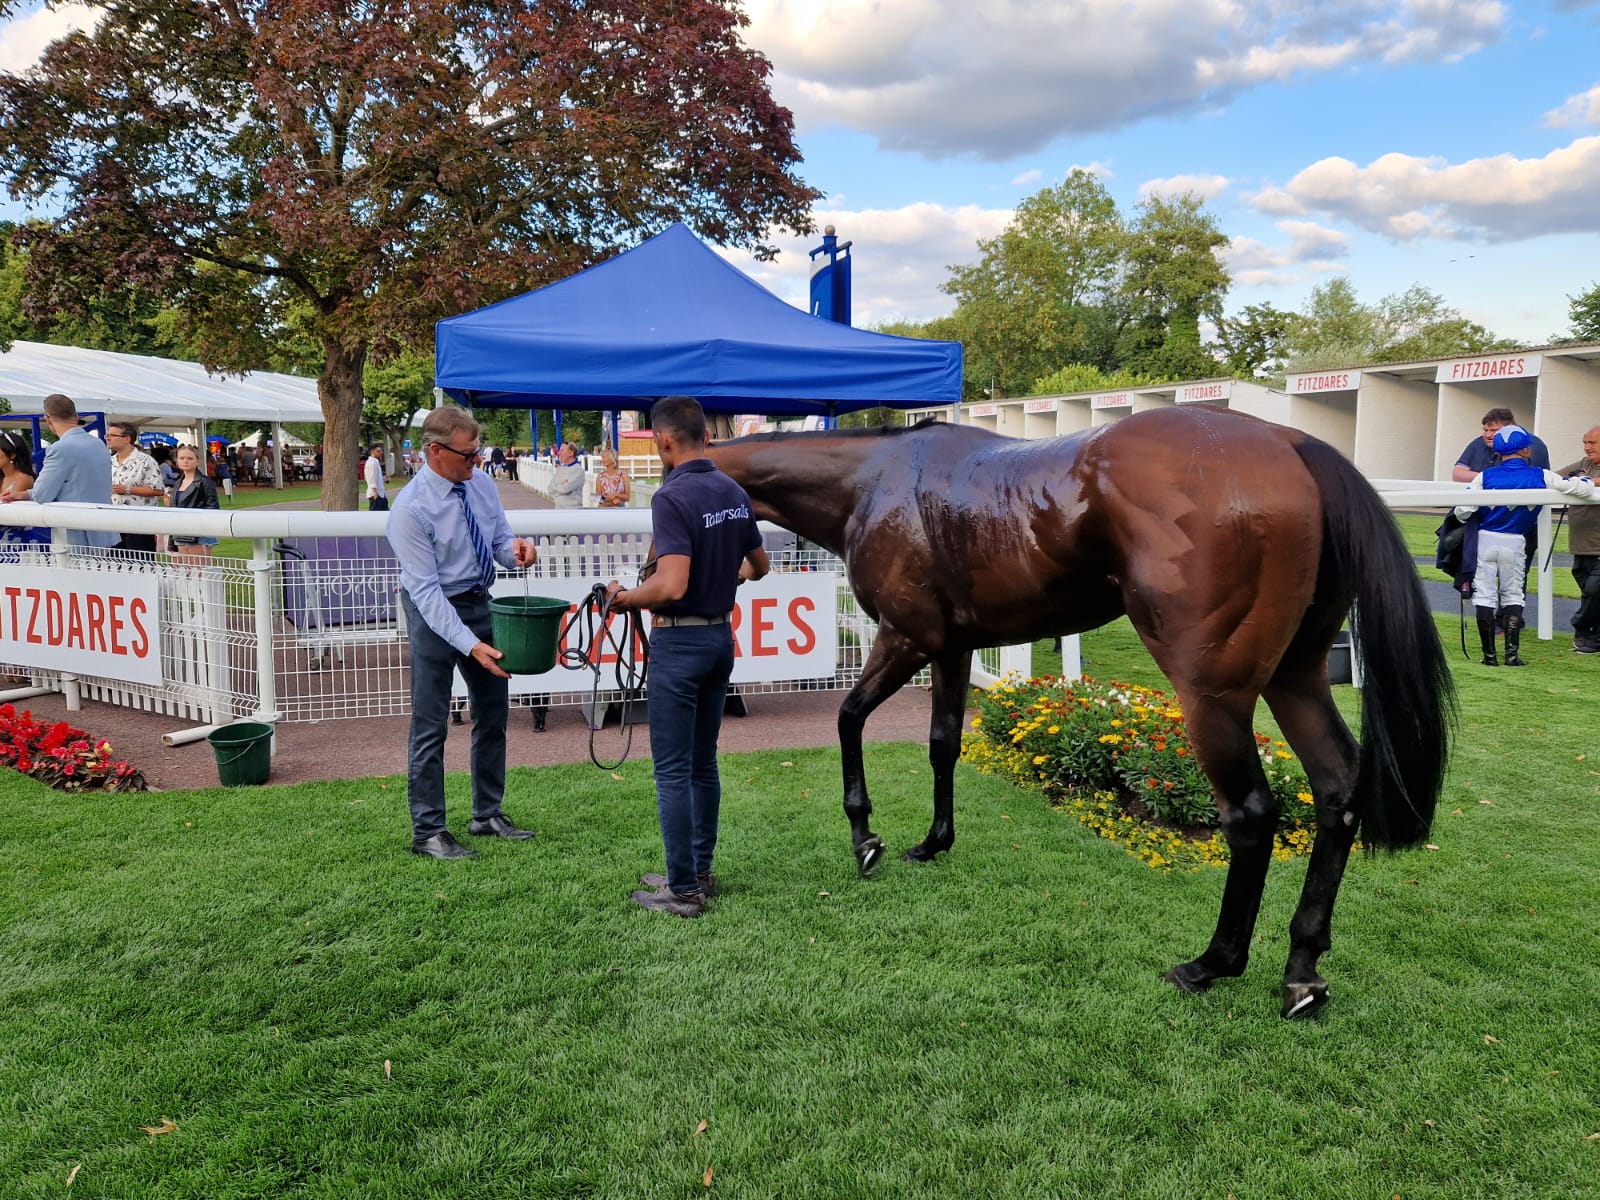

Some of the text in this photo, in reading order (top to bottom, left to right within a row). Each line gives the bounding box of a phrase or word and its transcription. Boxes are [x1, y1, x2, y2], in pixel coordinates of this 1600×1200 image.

[1452, 358, 1525, 379] FITZDARES
[1297, 374, 1349, 392] FITZDARES
[1097, 394, 1127, 406] FITZDARES
[1184, 385, 1222, 400] FITZDARES
